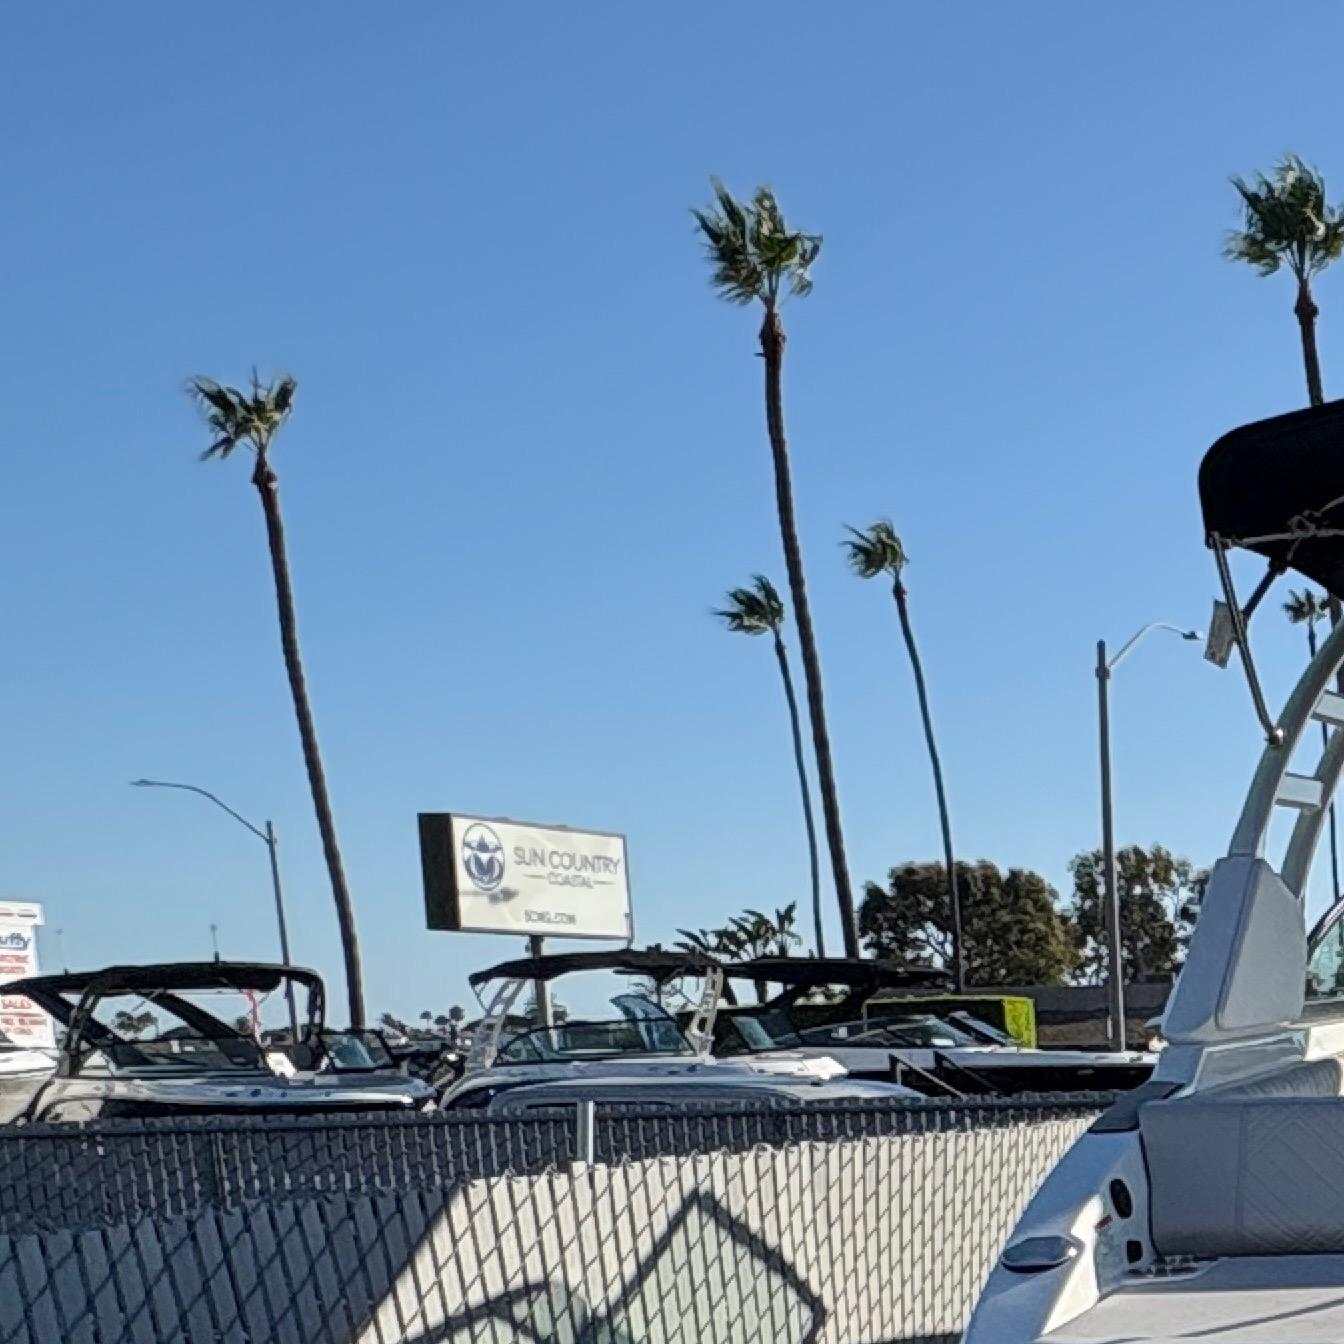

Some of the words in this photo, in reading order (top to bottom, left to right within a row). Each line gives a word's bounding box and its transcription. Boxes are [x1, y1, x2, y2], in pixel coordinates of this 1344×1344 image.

[513, 846, 546, 867] SUN
[548, 850, 620, 875] COUNTRY
[0, 932, 32, 951] uffy
